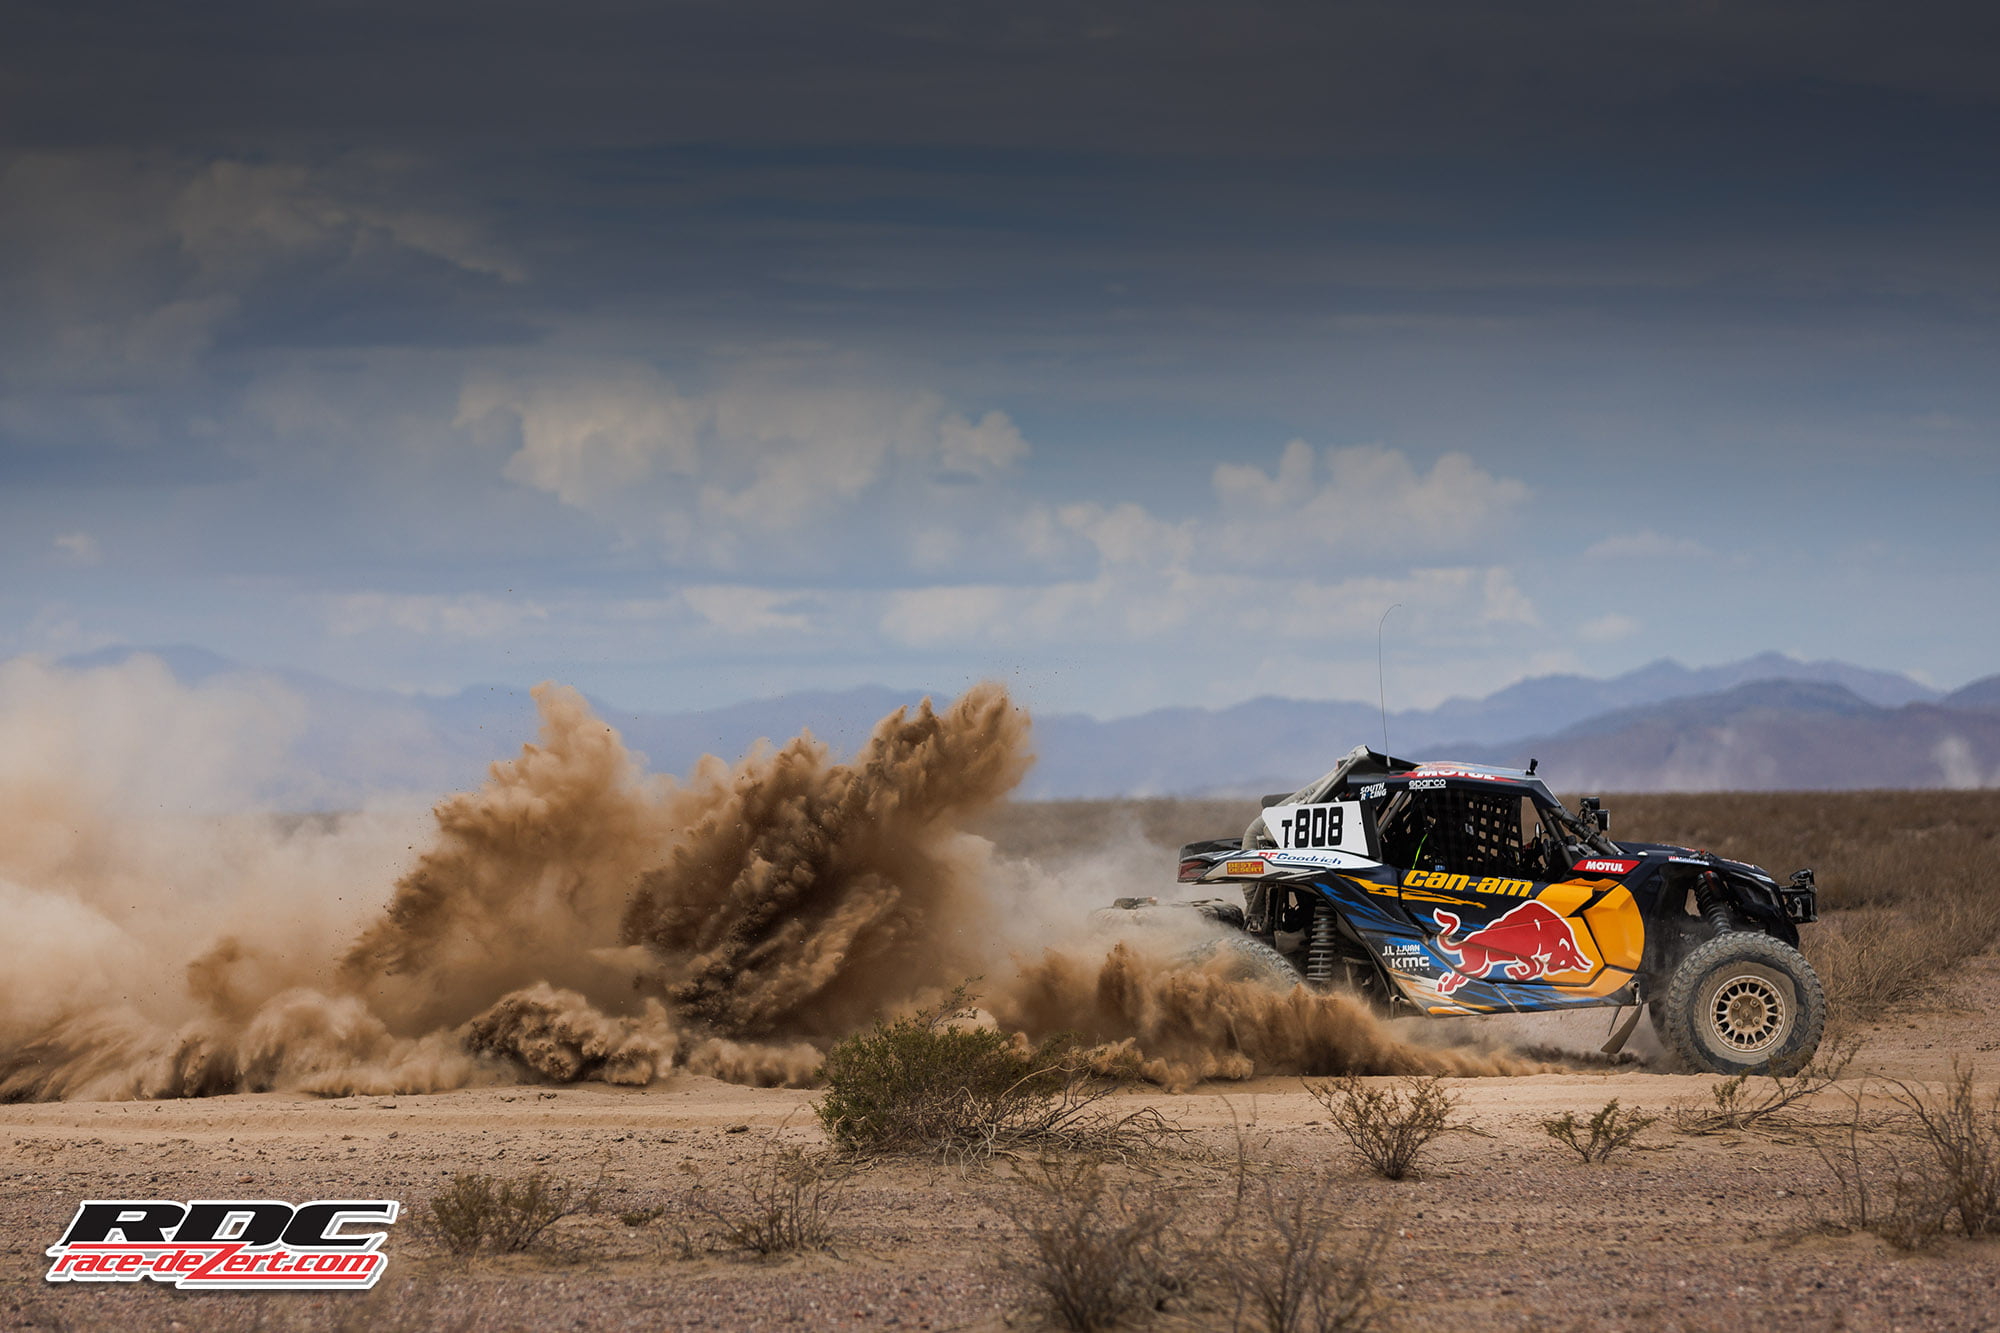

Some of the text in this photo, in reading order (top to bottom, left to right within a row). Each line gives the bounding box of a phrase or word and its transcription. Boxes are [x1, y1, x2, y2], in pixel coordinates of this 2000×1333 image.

[1360, 782, 1385, 795] SOUTH
[1281, 806, 1344, 848] T808
[1585, 861, 1624, 872] MOTUL
